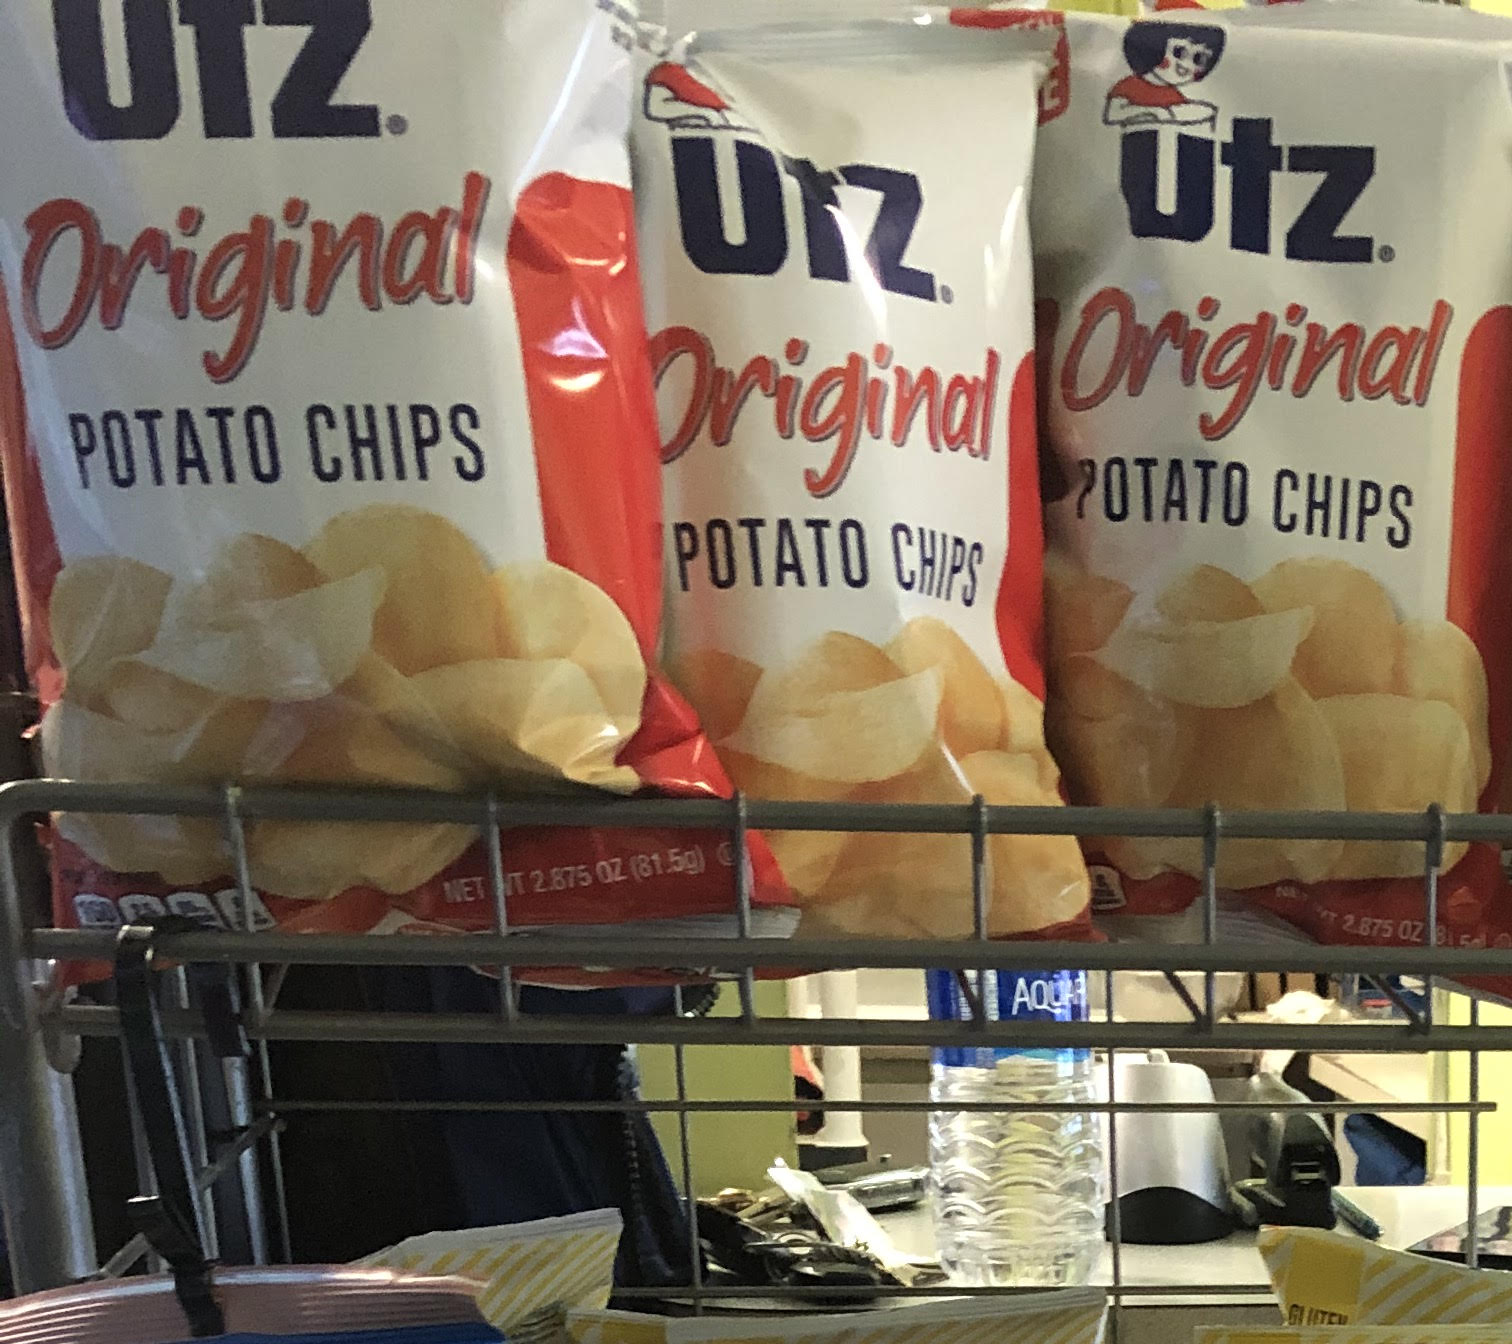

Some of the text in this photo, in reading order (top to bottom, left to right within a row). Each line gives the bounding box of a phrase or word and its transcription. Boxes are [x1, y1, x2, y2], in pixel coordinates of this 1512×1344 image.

[22, 170, 490, 383] Original
[1060, 287, 1454, 441] Original
[69, 403, 486, 490] POTATO CHIPS
[671, 517, 984, 607] POTATO CHIPS
[529, 864, 592, 894] 2.875
[596, 858, 627, 884] OZ
